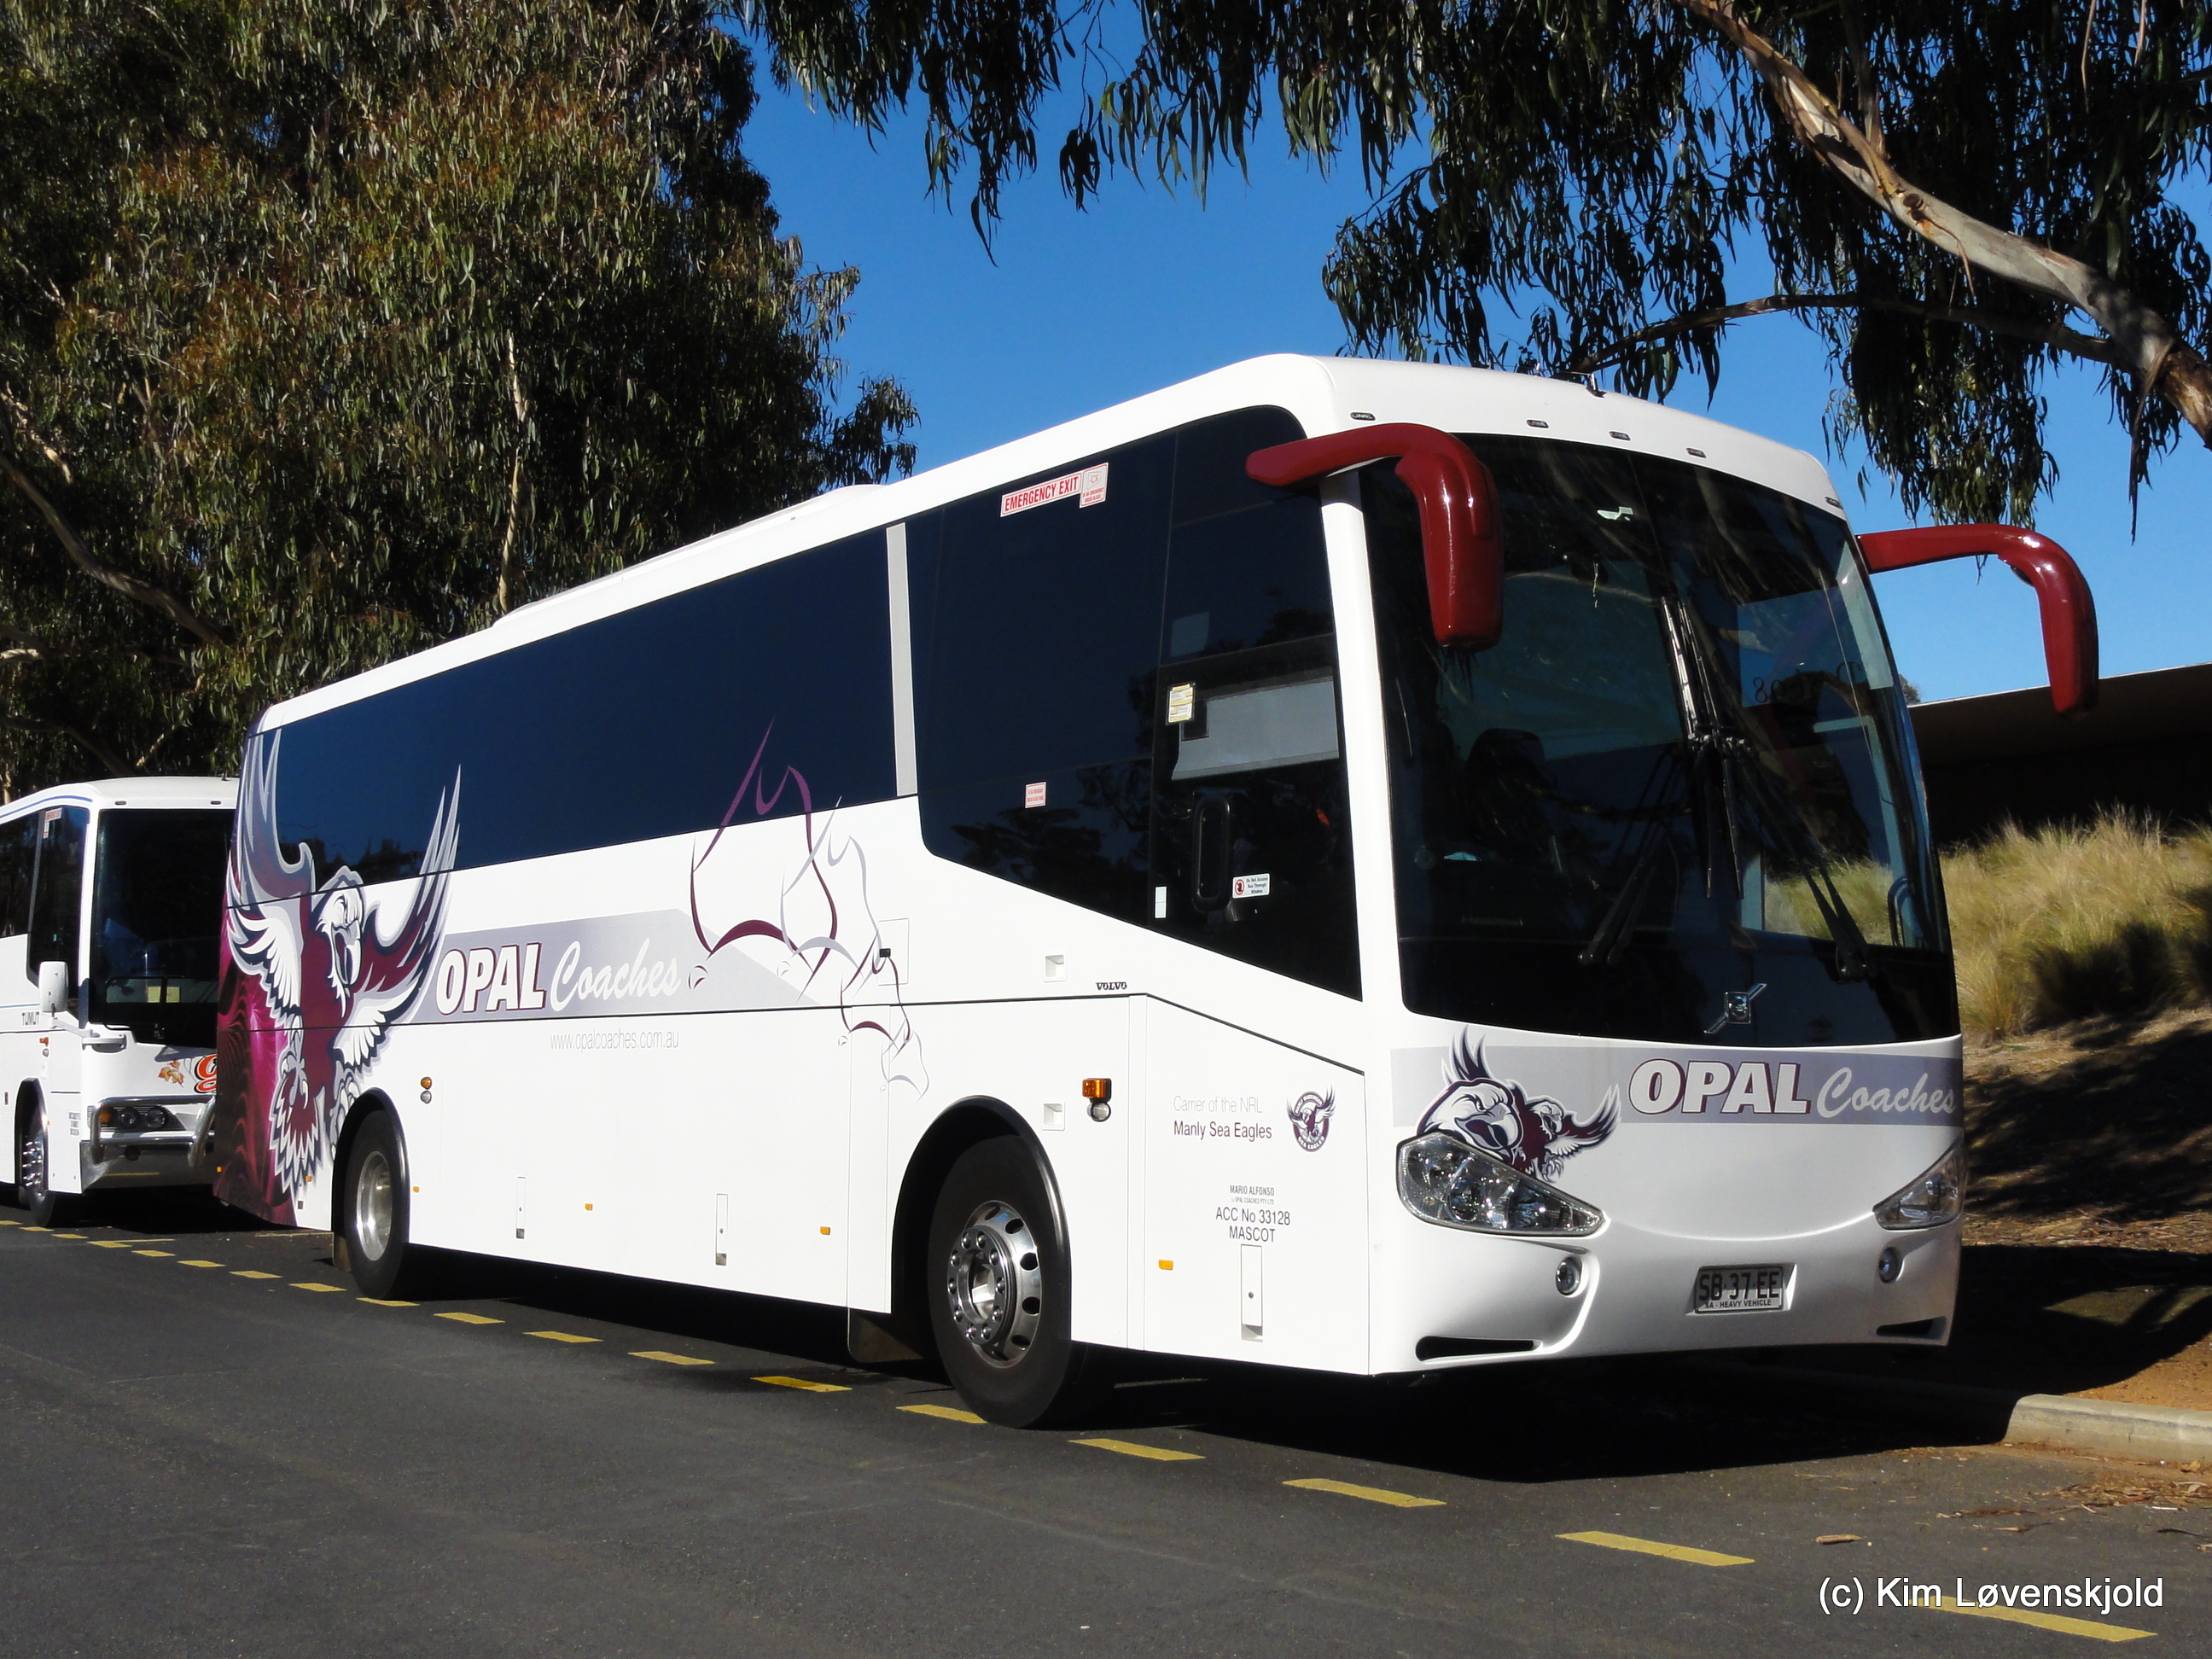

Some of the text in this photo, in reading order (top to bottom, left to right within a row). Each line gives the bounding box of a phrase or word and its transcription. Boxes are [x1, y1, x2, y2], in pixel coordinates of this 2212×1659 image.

[1004, 483, 1057, 512] EMERGENCY
[1058, 476, 1080, 495] EXIT
[435, 938, 681, 1016] OPAL Coaches
[1096, 981, 1127, 991] VOLVO
[550, 1027, 679, 1053] www.opalcoaches.com.au
[1628, 1058, 1957, 1119] OPAL Coaches
[1173, 1095, 1263, 1113] Carrier of the NRL
[1173, 1121, 1272, 1142] Manly Sea Eagles
[1230, 1185, 1275, 1196] MARIO ALFONSO
[1215, 1206, 1290, 1225] ACC No 33128
[1229, 1225, 1276, 1243] MASCOT
